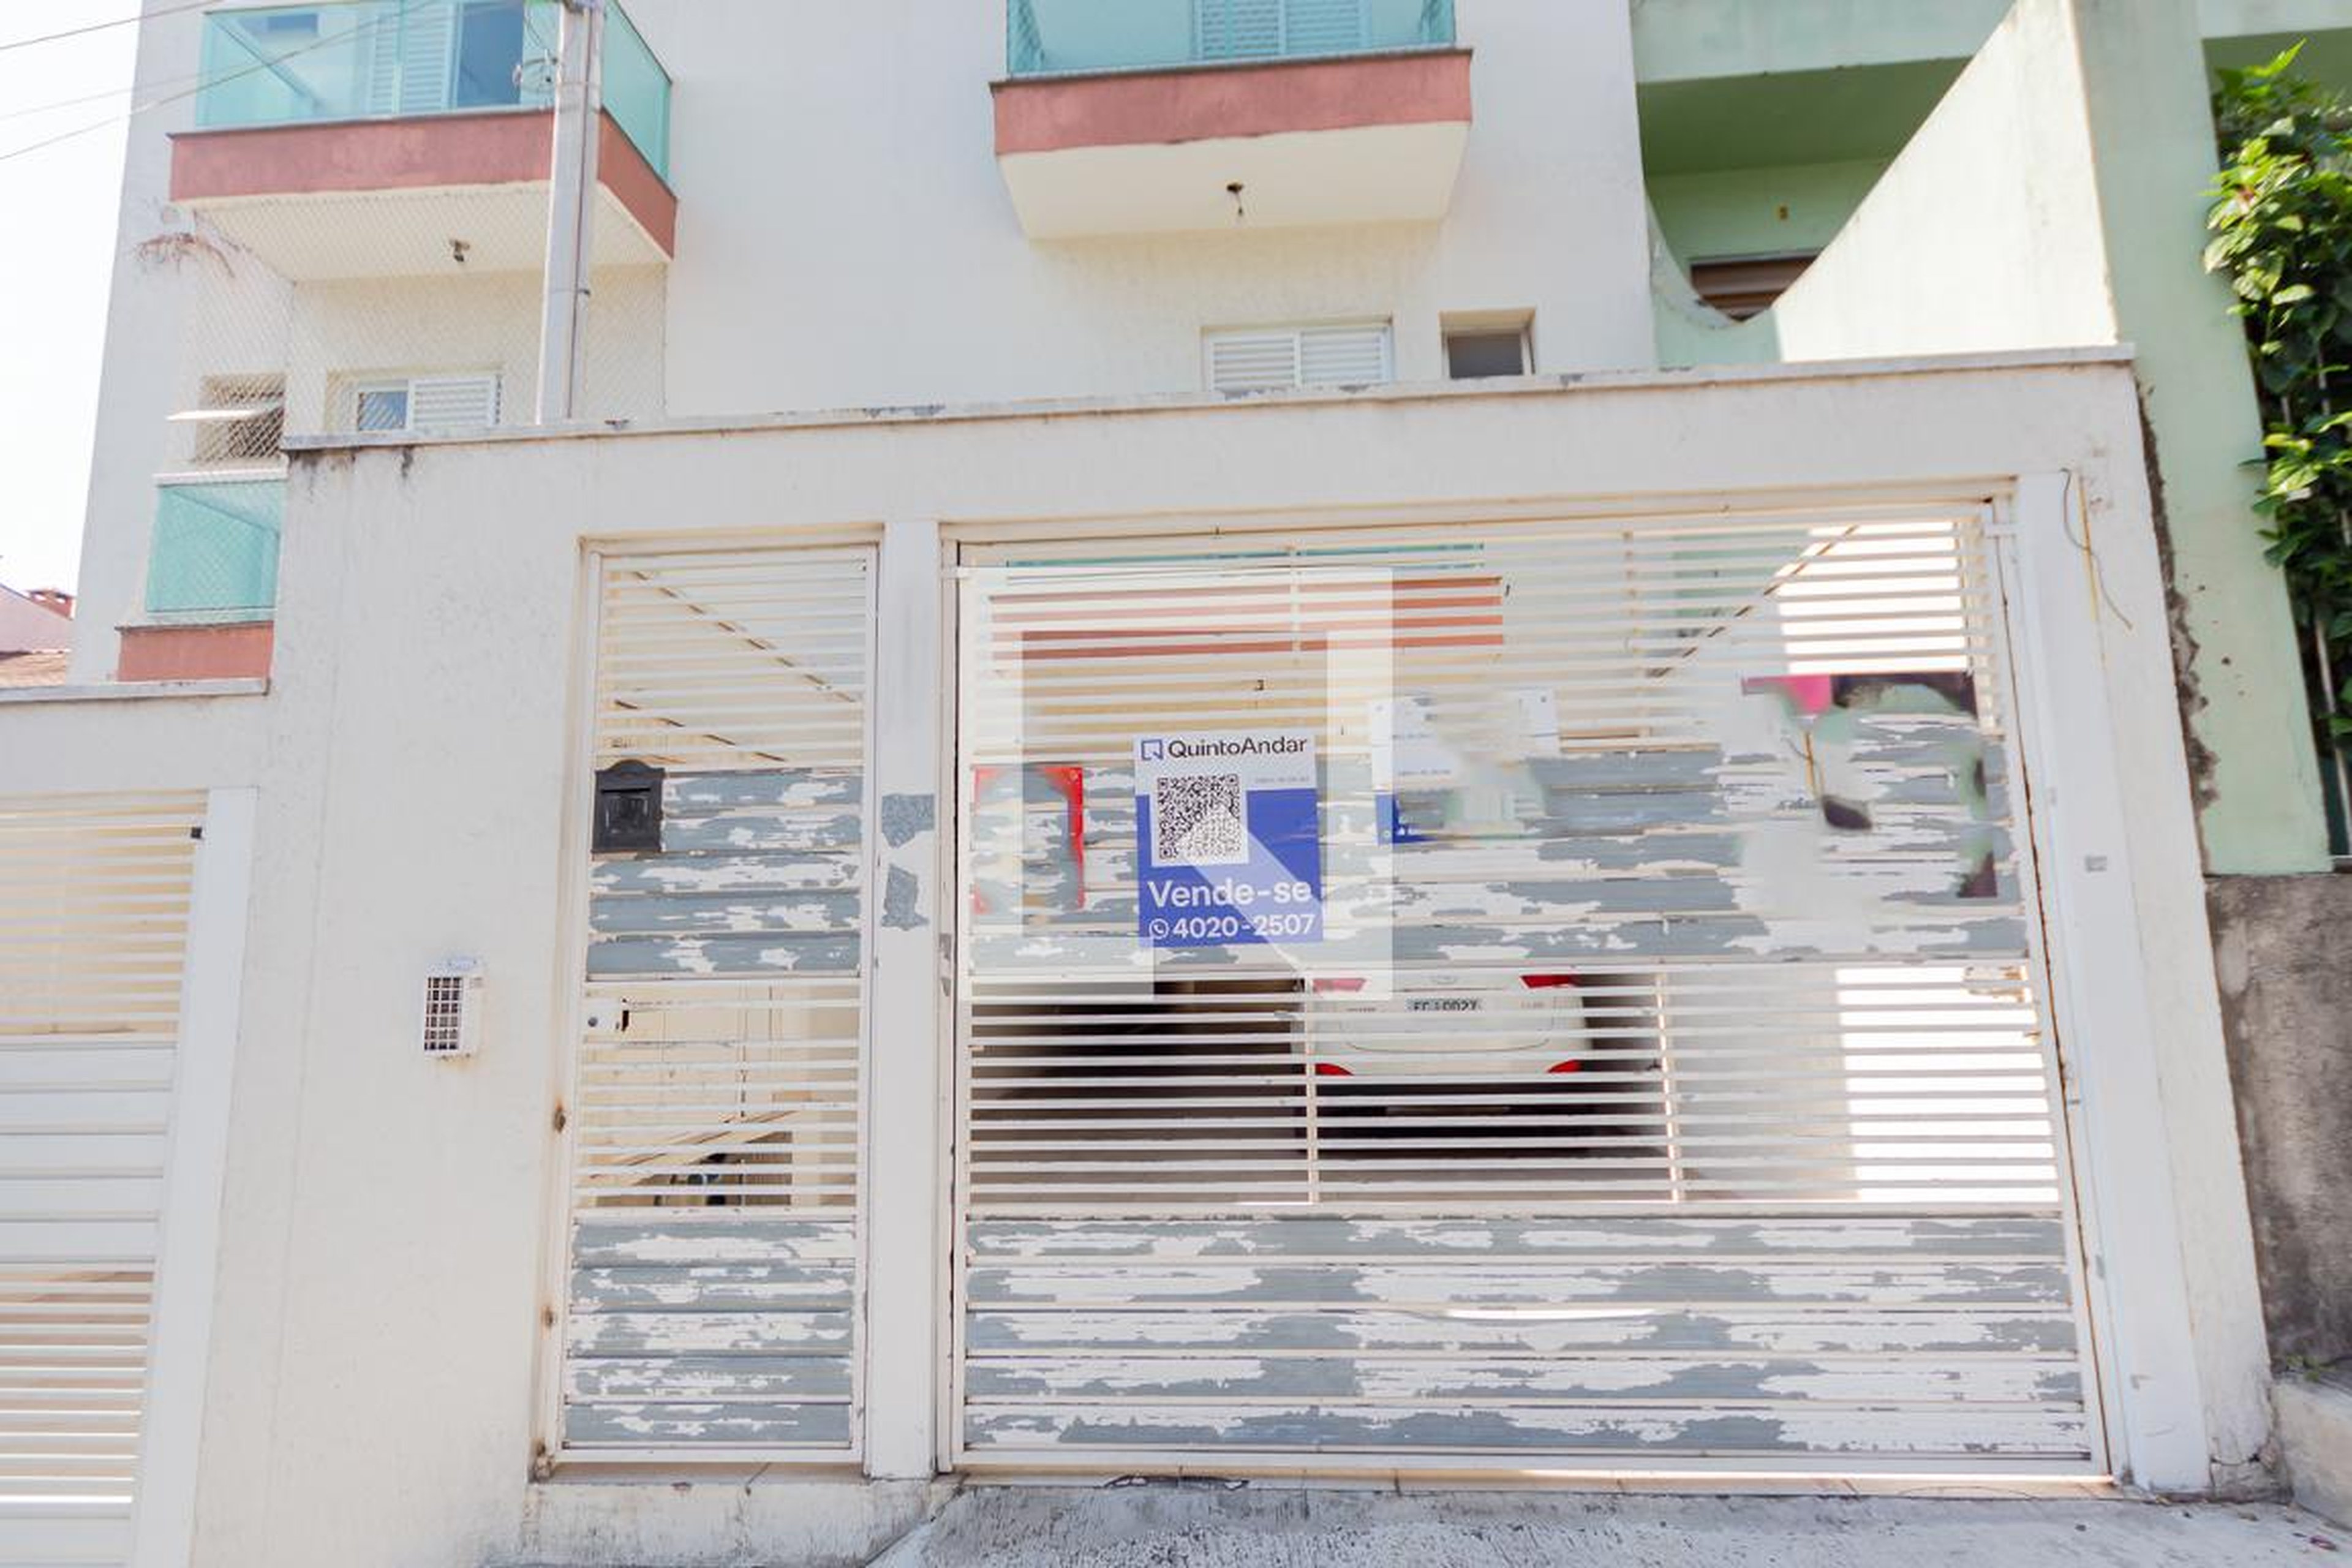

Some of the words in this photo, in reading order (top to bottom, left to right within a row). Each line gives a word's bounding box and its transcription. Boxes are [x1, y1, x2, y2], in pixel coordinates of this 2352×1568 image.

[1168, 737, 1307, 758] QuintoAndar
[1148, 878, 1312, 907] Vende-se
[1173, 914, 1315, 938] 4020-2507
